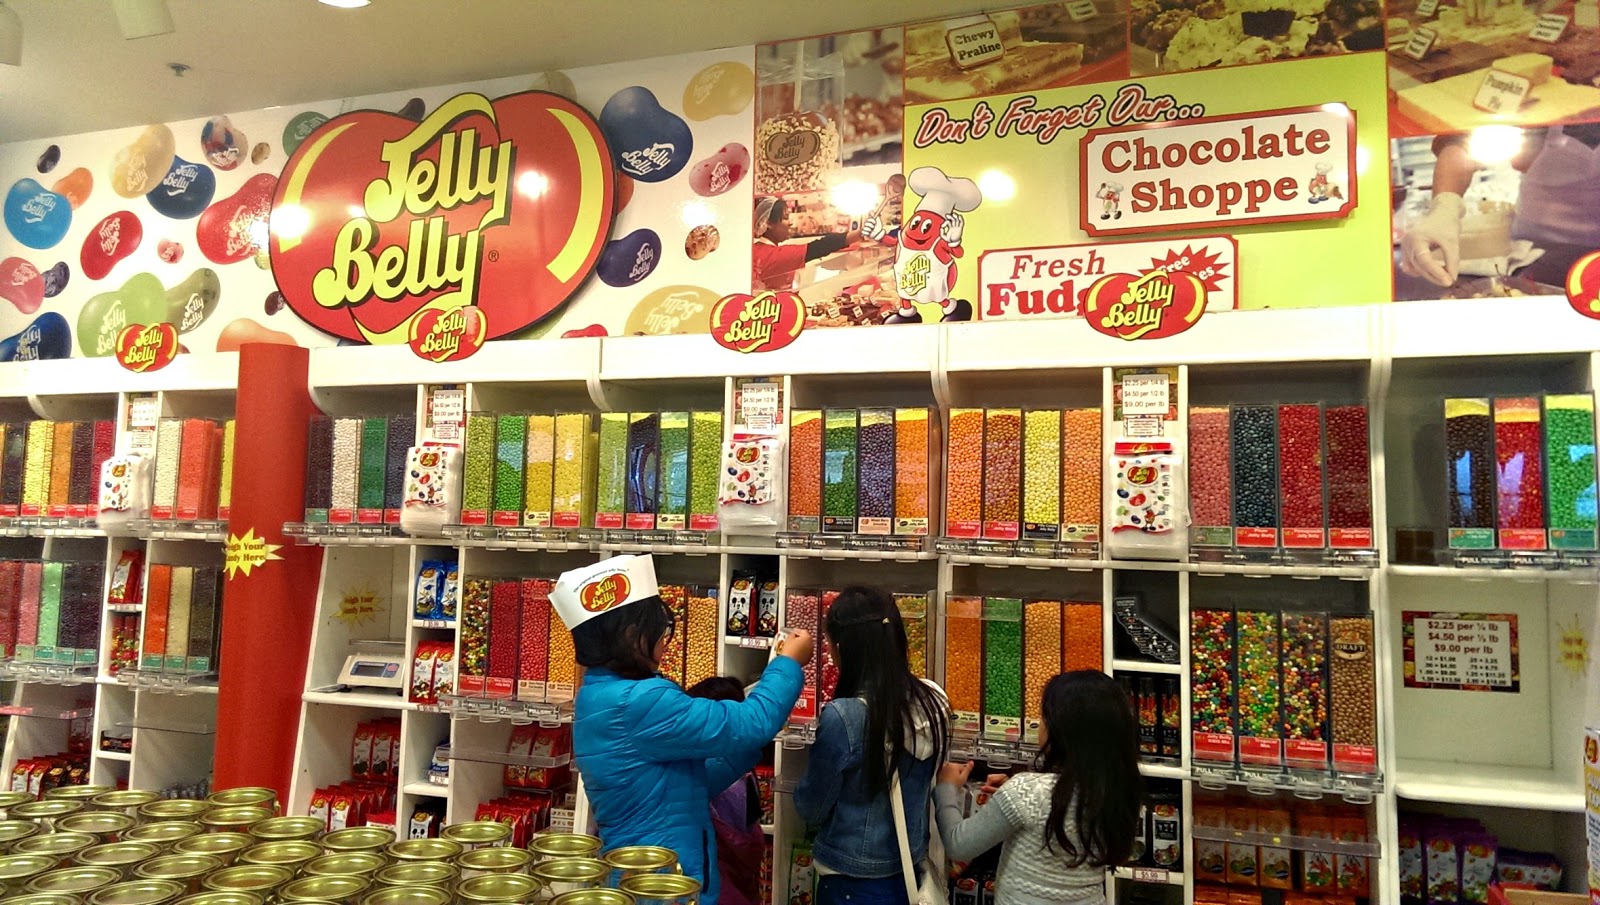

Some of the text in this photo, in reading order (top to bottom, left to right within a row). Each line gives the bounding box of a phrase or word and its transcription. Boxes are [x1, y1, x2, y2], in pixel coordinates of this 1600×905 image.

[954, 30, 994, 44] Chewy
[957, 43, 1001, 60] Praline
[914, 101, 993, 147] Don't
[996, 94, 1106, 144] Forget
[783, 130, 805, 148] Jelly
[1102, 124, 1330, 173] Chocolate
[364, 92, 513, 229] Jelly
[621, 150, 653, 175] Belly
[643, 143, 674, 170] Jelly
[774, 148, 800, 164] Belly
[176, 165, 198, 182] Jelly
[710, 175, 730, 192] Belly
[711, 162, 729, 181] Jelly
[163, 172, 190, 196] Belly
[1131, 177, 1298, 215] Shoppe
[34, 193, 56, 211] Jelly
[636, 243, 654, 265] Jelly
[904, 252, 930, 274] Jelly
[1010, 250, 1106, 279] Fresh
[312, 217, 480, 345] Belly
[629, 263, 650, 281] Belly
[900, 272, 926, 296] Belly
[1121, 270, 1174, 307] Jelly
[101, 300, 126, 334] Jelly
[185, 293, 204, 318] Jelly
[739, 291, 781, 322] Jelly
[181, 311, 203, 330] Belly
[433, 306, 467, 335] Jelly
[1101, 303, 1162, 340] Belly
[97, 330, 117, 355] Bell
[135, 323, 163, 348] Jelly
[420, 332, 459, 363] Belly
[724, 320, 772, 353] Belly
[124, 346, 156, 372] Belly
[595, 576, 617, 595] Jelly
[591, 592, 616, 611] Belly
[1428, 621, 1454, 629] $2.25
[1489, 623, 1498, 631] lb
[1336, 643, 1364, 652] DRAFT
[1435, 644, 1460, 652] $9.00
